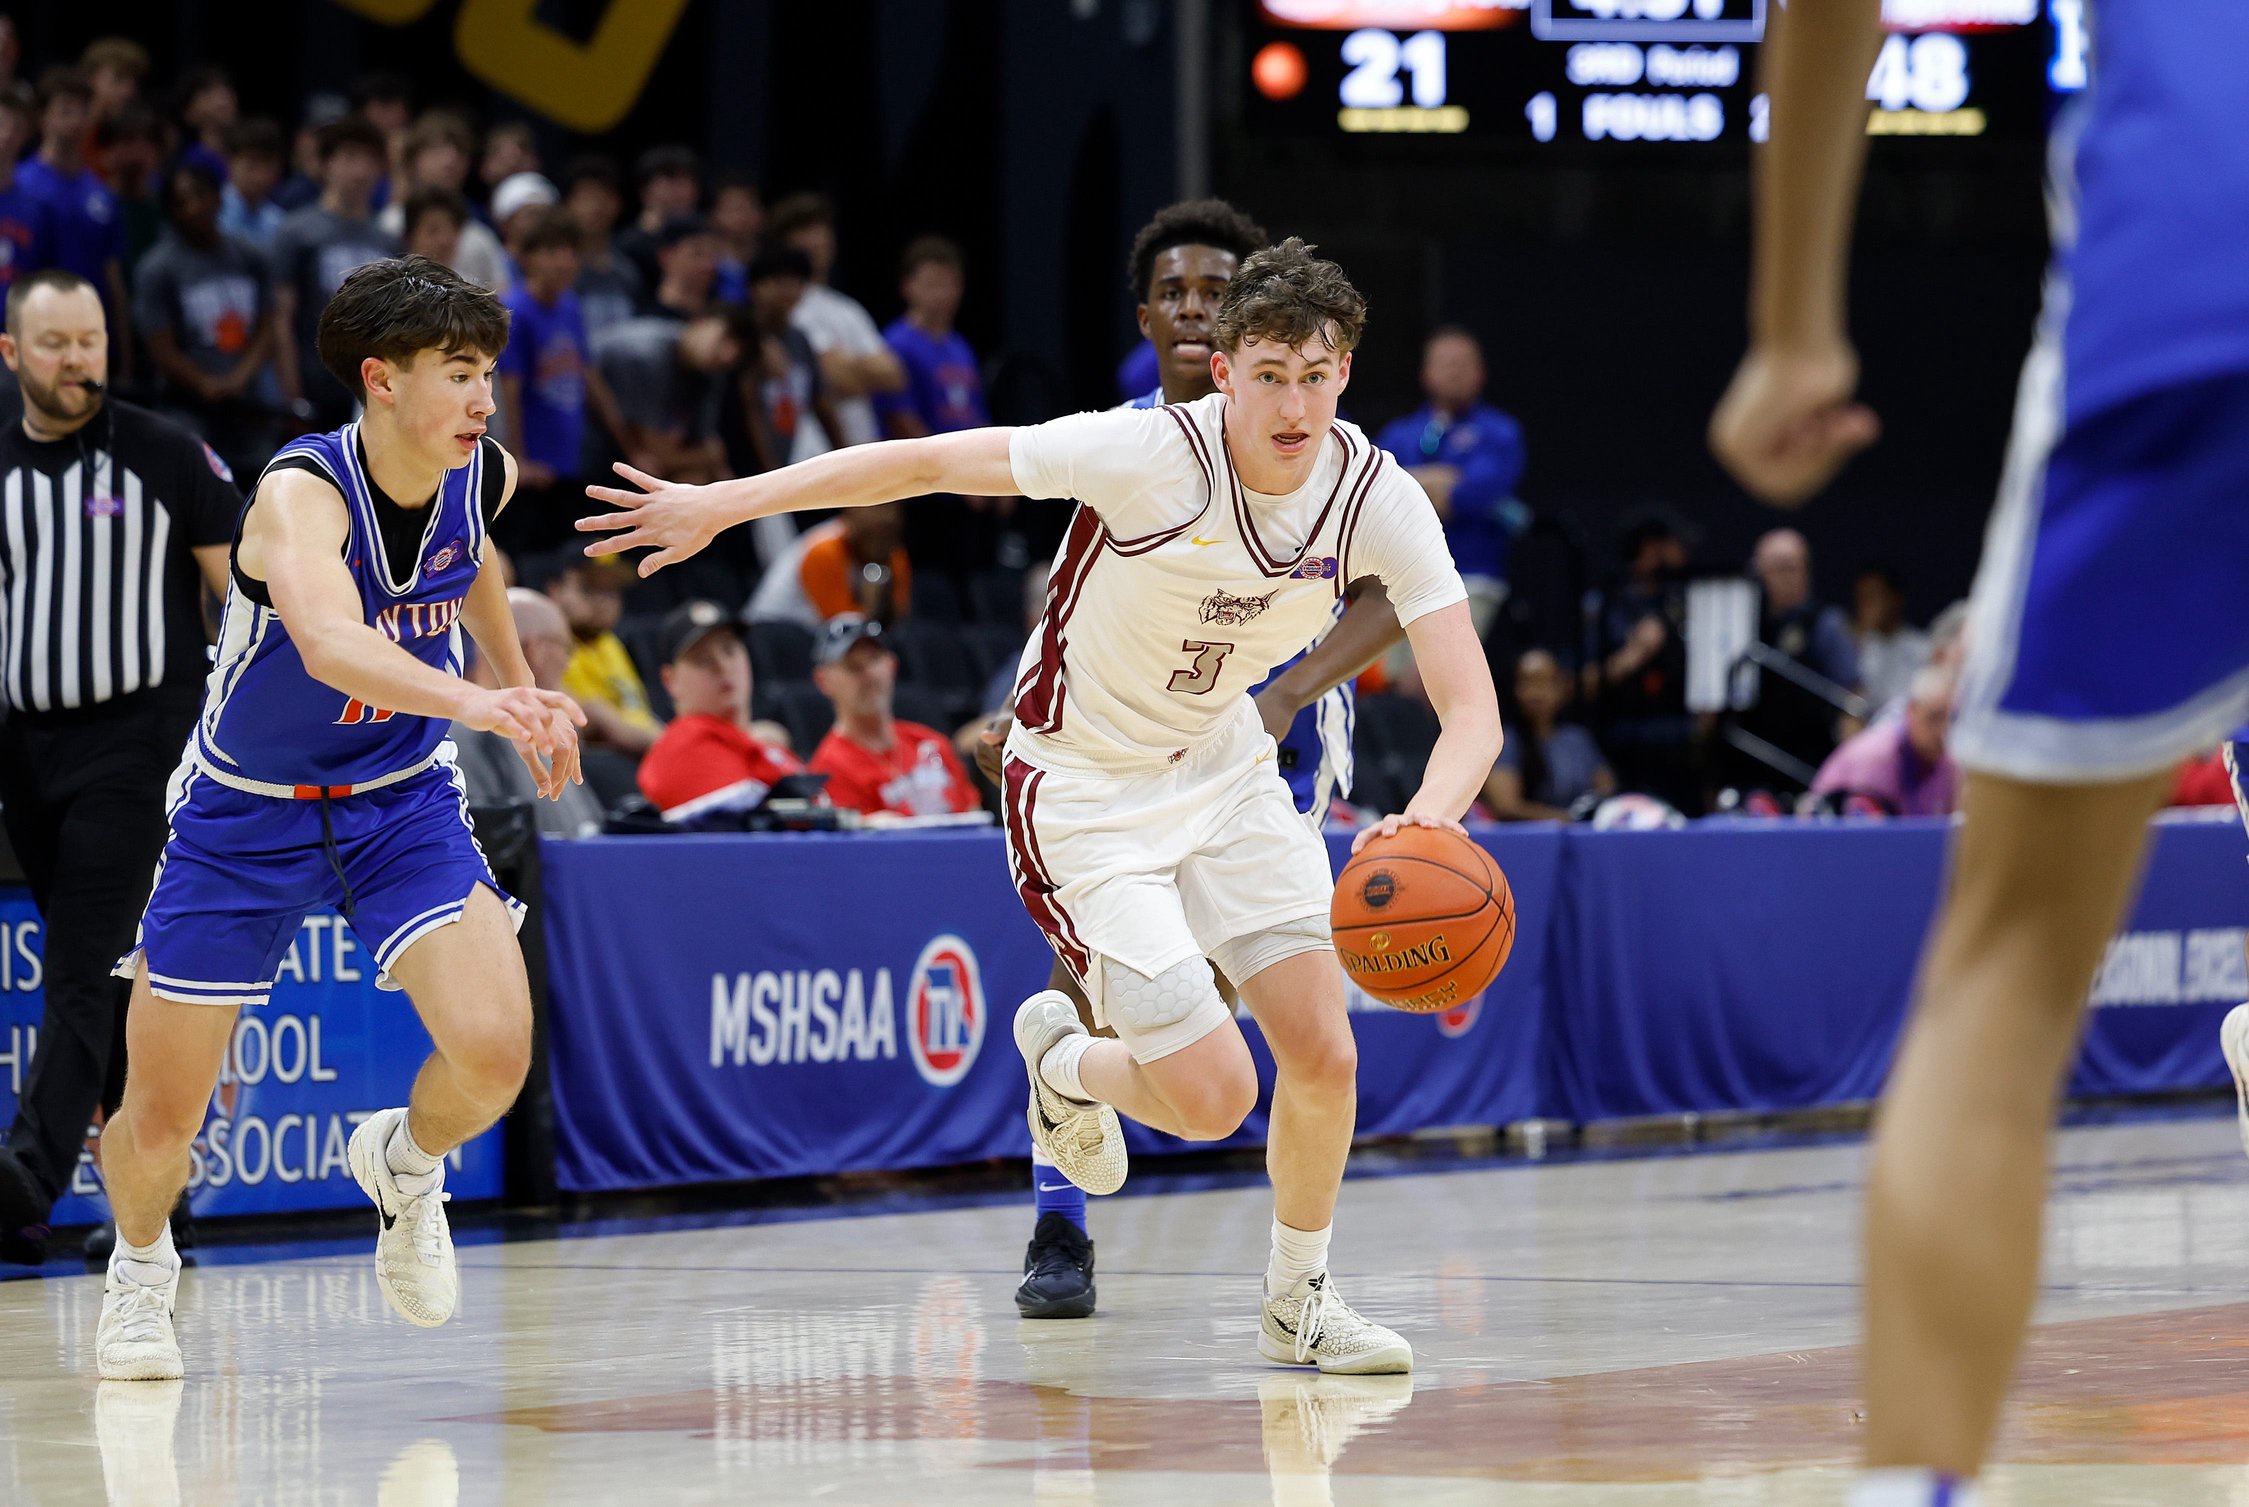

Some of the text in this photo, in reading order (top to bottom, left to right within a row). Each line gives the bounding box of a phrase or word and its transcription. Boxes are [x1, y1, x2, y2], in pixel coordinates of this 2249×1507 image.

[1338, 27, 1447, 109] 21
[1865, 32, 1970, 112] 48
[1524, 91, 1557, 143] 1
[1582, 92, 1725, 142] FOULS
[1166, 638, 1235, 695] 3
[709, 966, 898, 1068] MSHSAA
